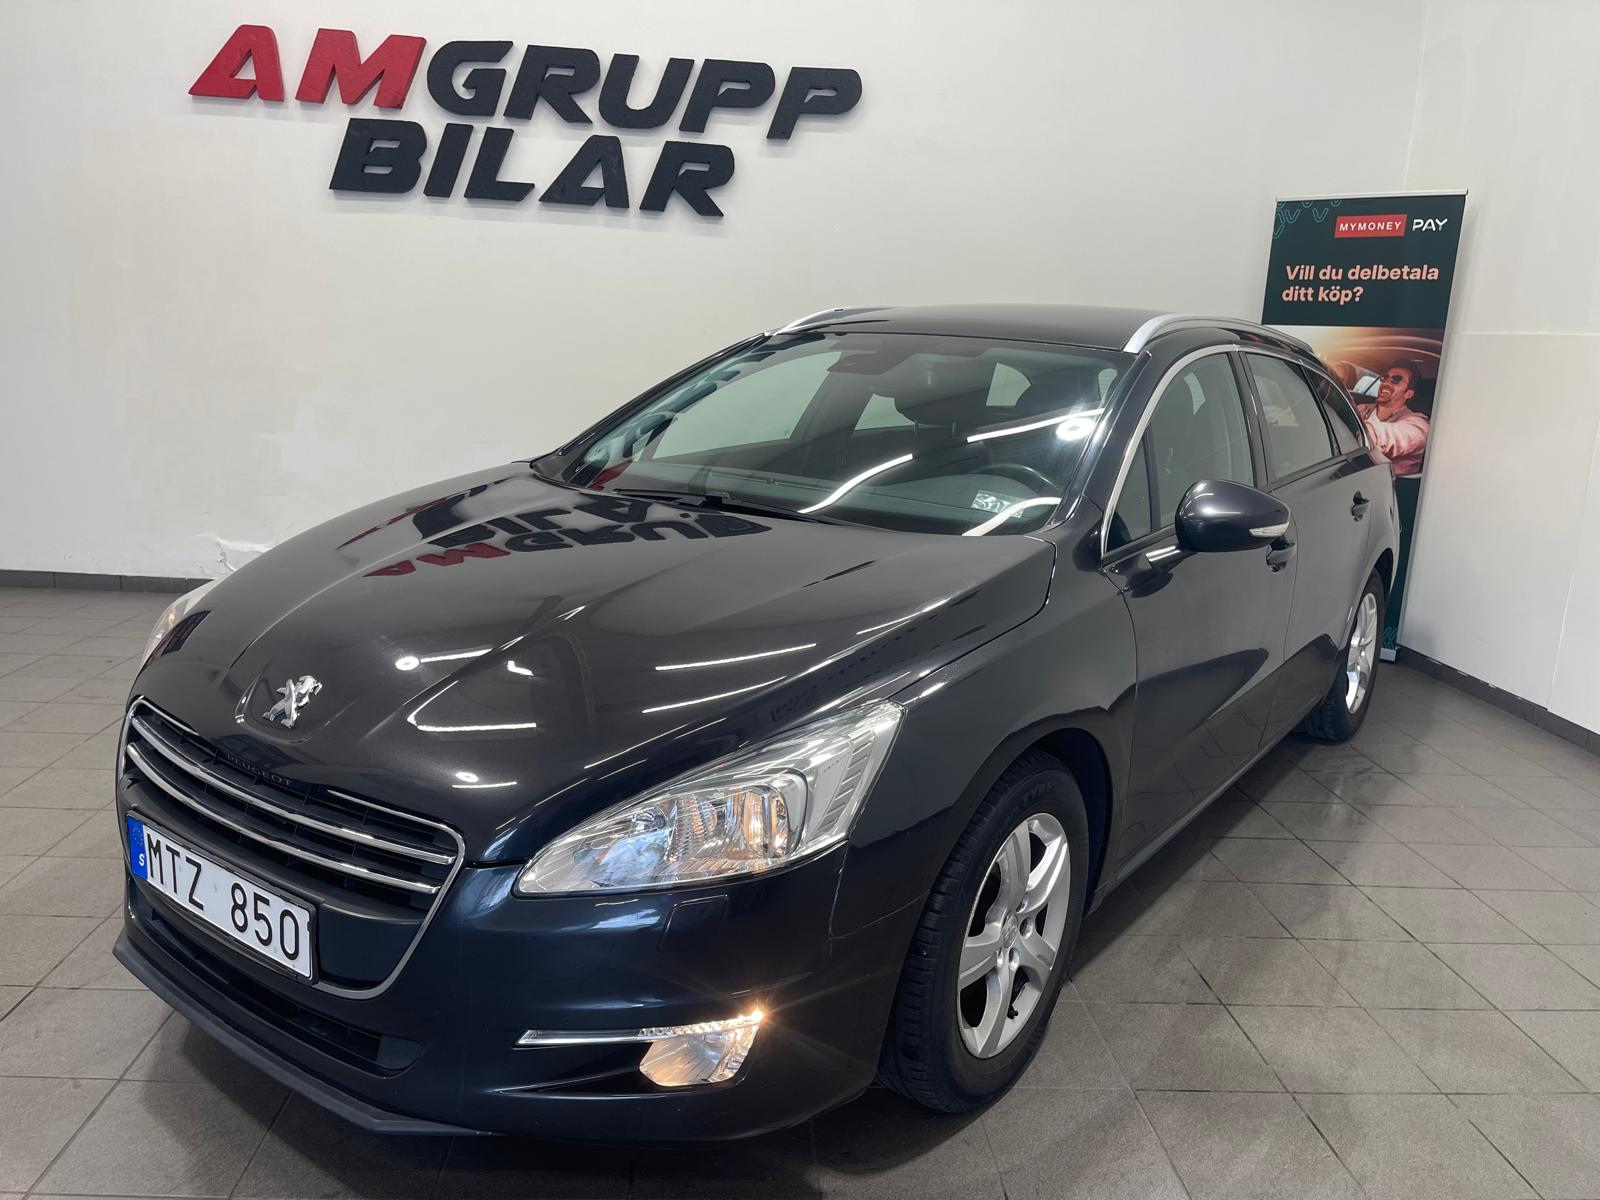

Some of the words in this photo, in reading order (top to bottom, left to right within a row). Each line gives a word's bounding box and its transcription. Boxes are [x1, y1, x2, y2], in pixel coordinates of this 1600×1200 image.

[328, 118, 735, 217] BILAR
[1339, 221, 1402, 232] MYMONEY
[1412, 218, 1448, 231] PAY
[1286, 265, 1315, 280] Vill
[1319, 265, 1342, 280] du
[1348, 264, 1439, 280] delbetala
[1282, 286, 1314, 302] ditt
[1318, 286, 1364, 305] köp?
[139, 853, 145, 867] S
[146, 833, 205, 911] MTZ
[230, 882, 300, 961] 850
